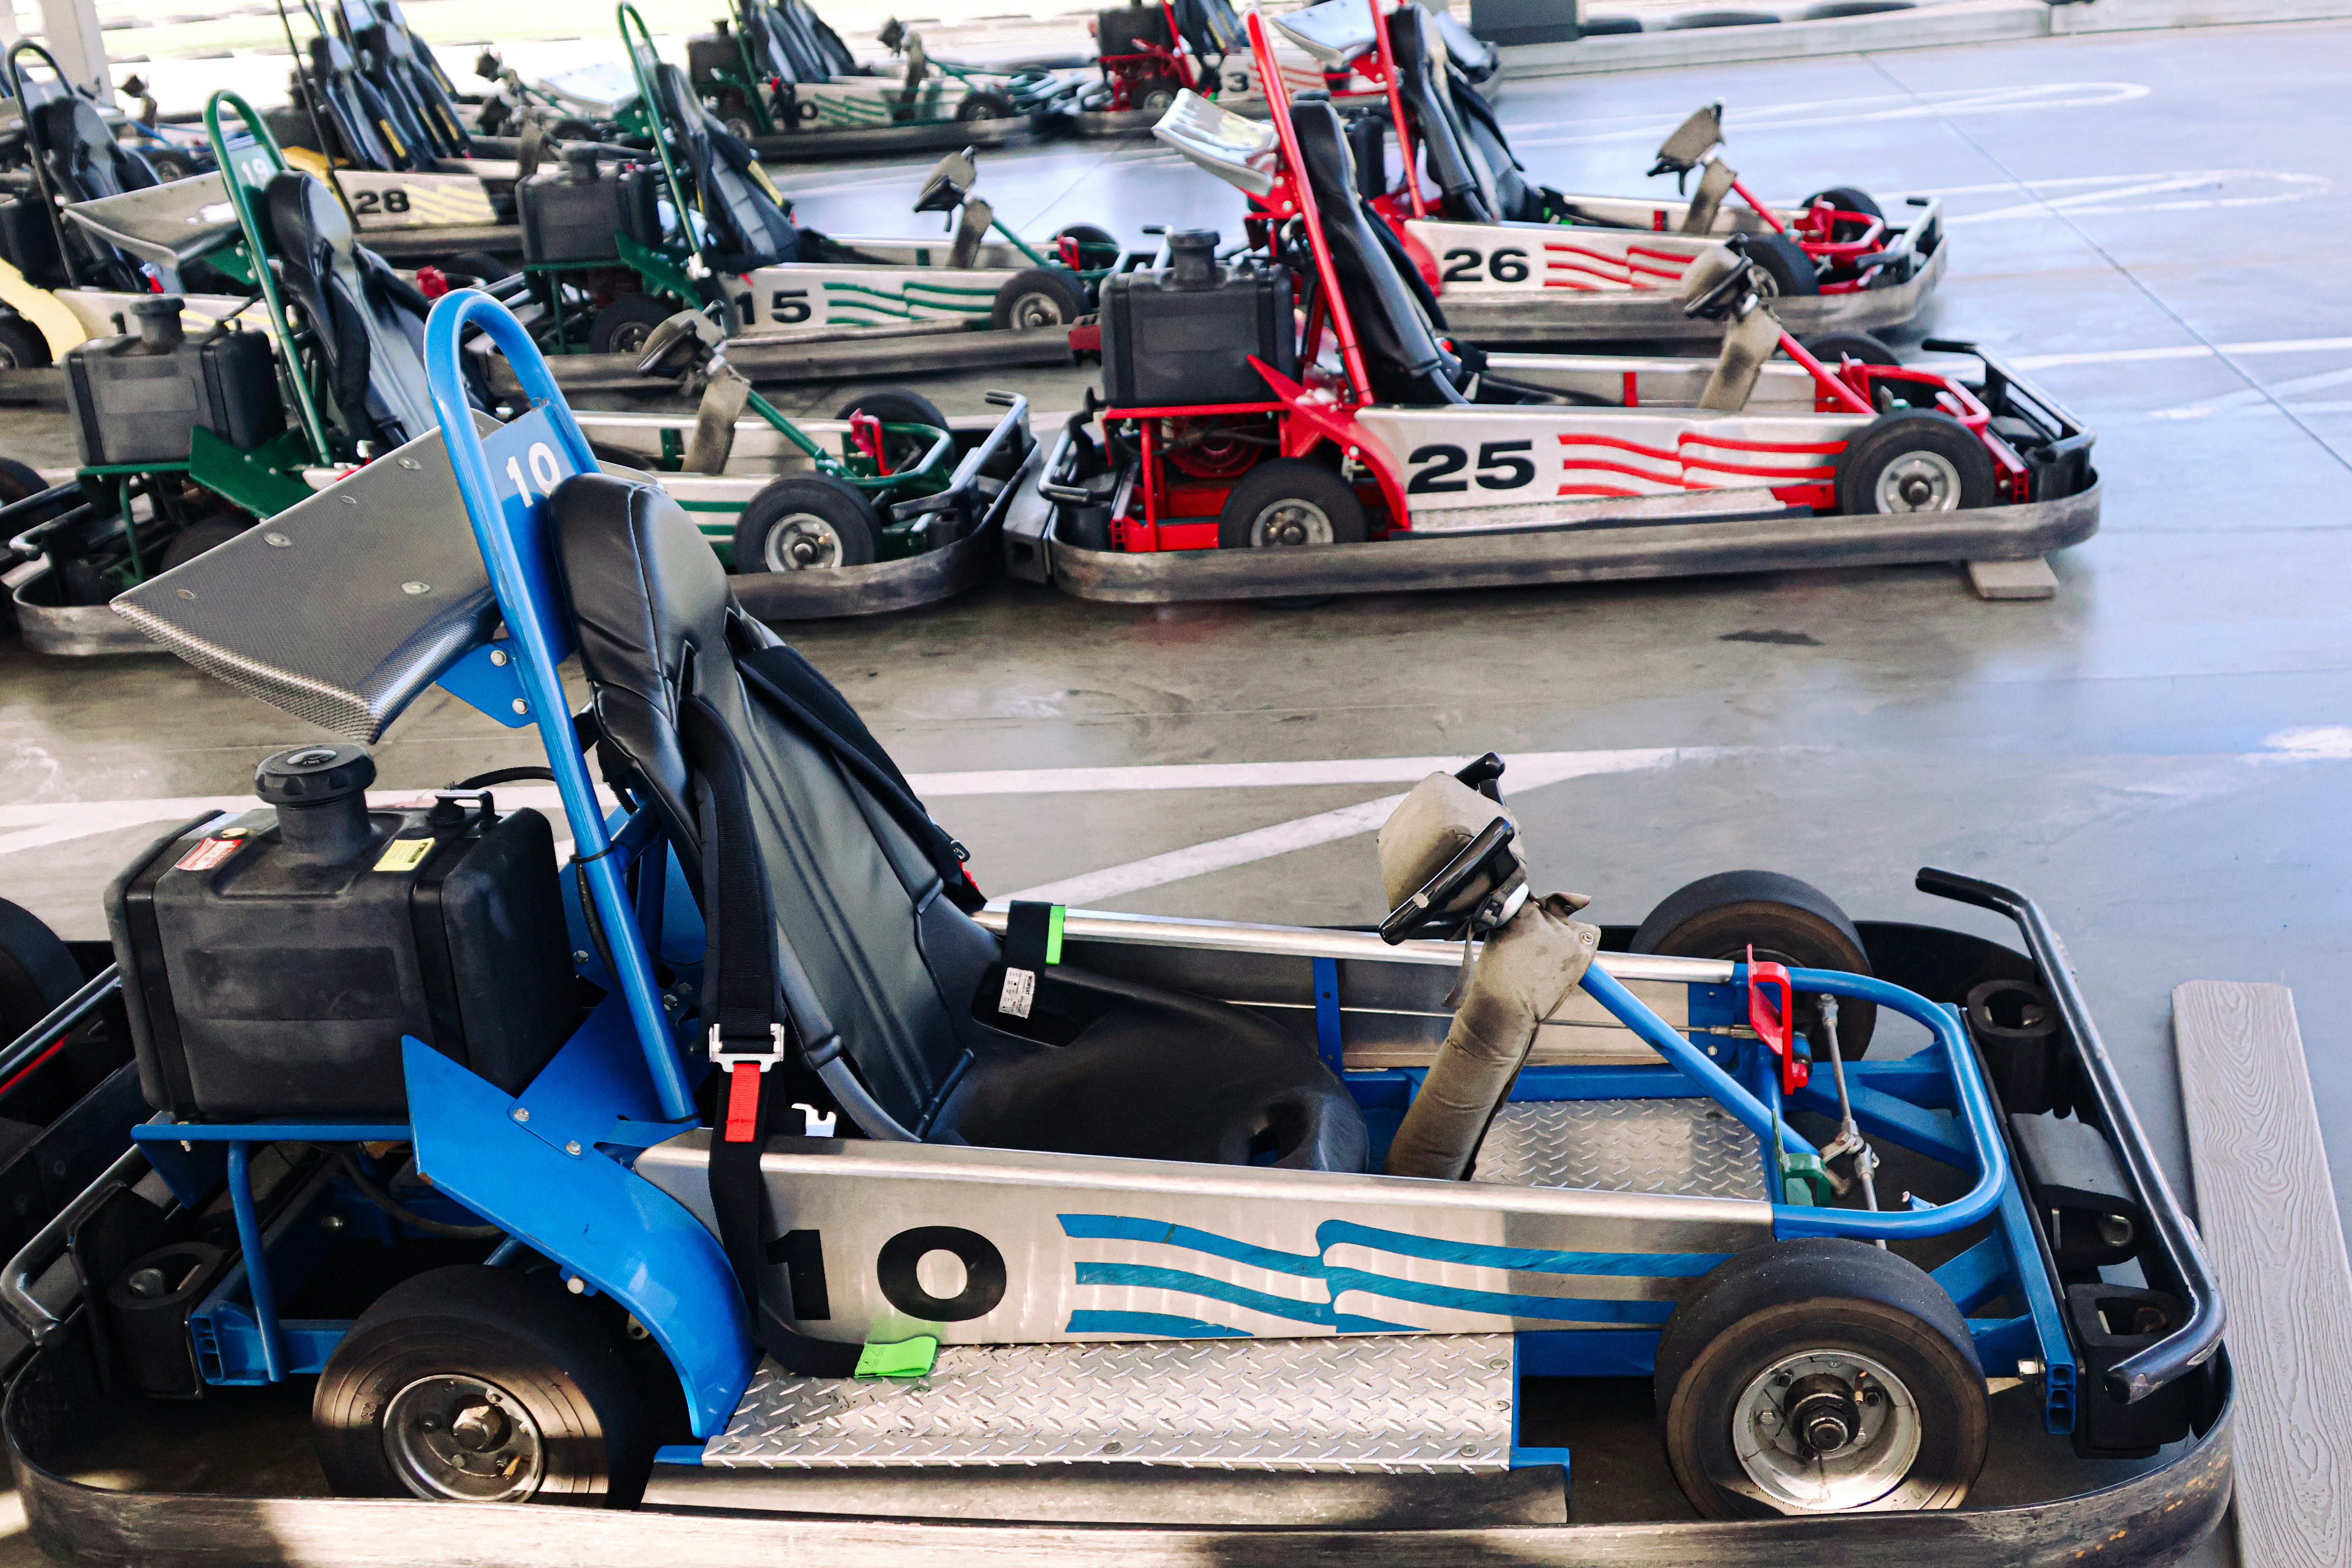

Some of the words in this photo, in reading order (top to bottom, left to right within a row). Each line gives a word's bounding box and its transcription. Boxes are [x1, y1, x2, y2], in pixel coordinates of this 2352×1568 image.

[241, 157, 270, 185] 19
[354, 189, 410, 214] 28
[1443, 248, 1529, 282] 26
[735, 290, 811, 325] 15
[506, 442, 561, 507] 10
[1407, 439, 1535, 494] 25
[766, 1225, 1007, 1322] 10
